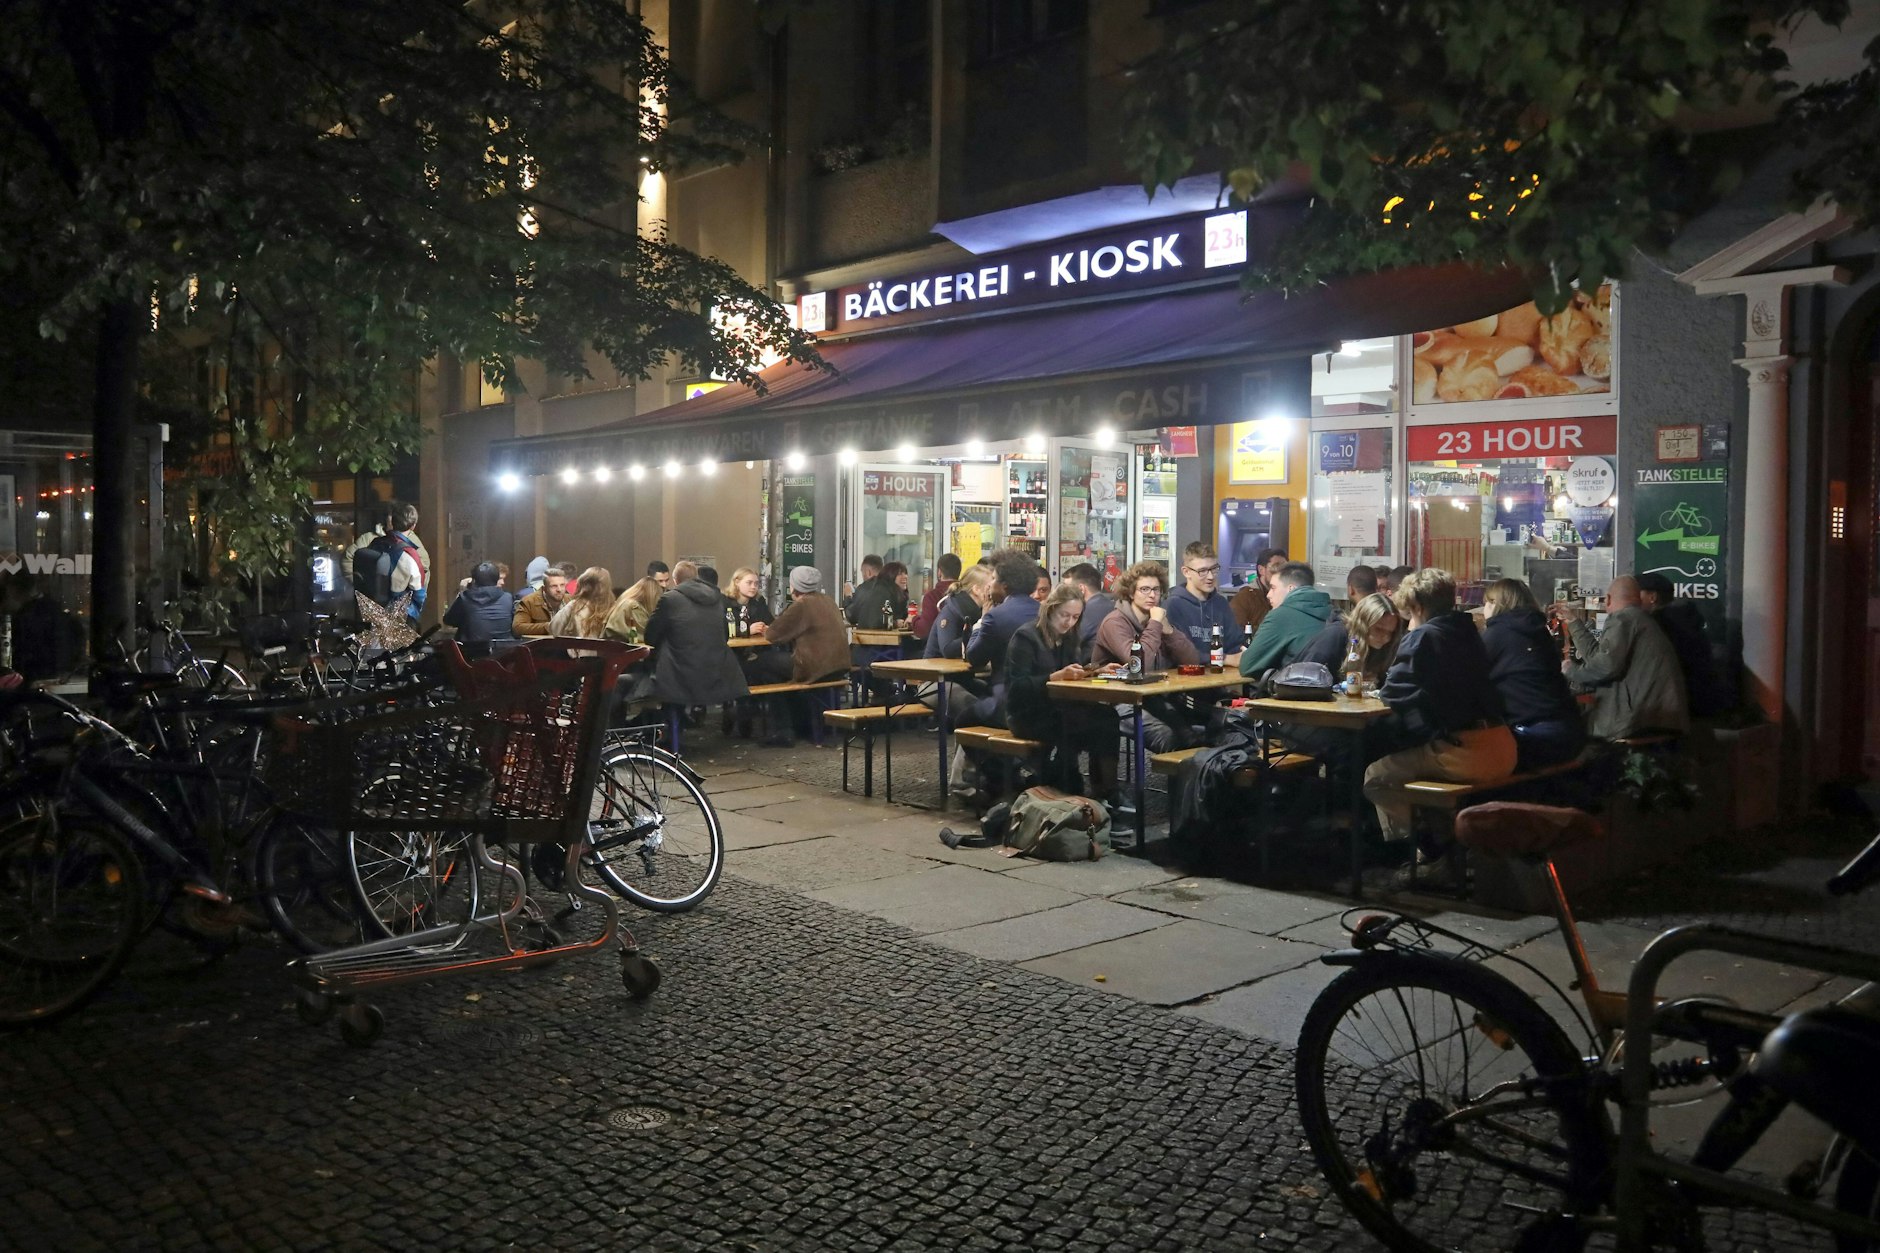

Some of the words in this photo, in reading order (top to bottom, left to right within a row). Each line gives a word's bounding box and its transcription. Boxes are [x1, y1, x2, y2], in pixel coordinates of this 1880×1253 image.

[1207, 228, 1245, 252] 23h
[845, 265, 1009, 321] BÄCKEREI
[1023, 270, 1037, 281] -
[1050, 233, 1183, 287] KIOSK
[821, 410, 934, 446] GETRÄNKE
[1004, 395, 1081, 432] ATM
[1115, 382, 1209, 421] CASH
[1437, 431, 1472, 455] 23
[1483, 425, 1585, 453] HOUR
[1321, 445, 1330, 458] 9
[1340, 444, 1354, 458] 10
[1572, 467, 1598, 478] skruf
[1637, 468, 1725, 483] TANKSTELLE
[882, 476, 928, 493] HOUR
[784, 543, 814, 554] E-BIKES
[1681, 541, 1717, 551] E-BIKES
[23, 553, 93, 575] Wall
